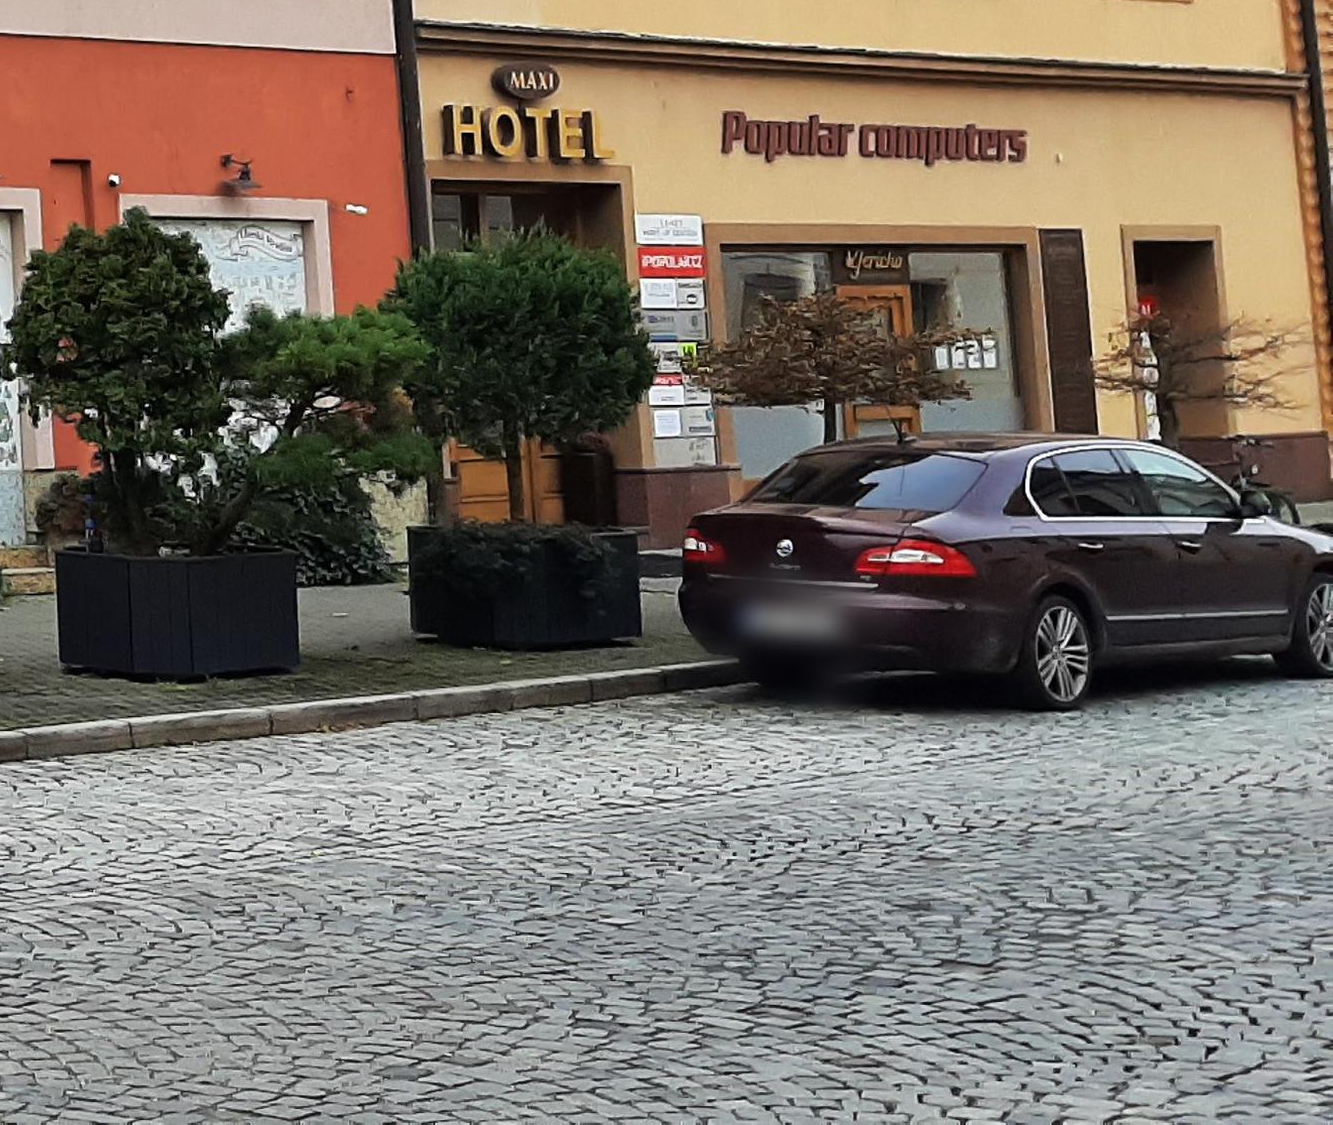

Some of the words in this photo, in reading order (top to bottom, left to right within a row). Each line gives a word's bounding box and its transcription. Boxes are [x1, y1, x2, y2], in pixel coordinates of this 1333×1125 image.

[509, 71, 555, 91] MAXI
[441, 103, 615, 160] HOTEL
[720, 110, 855, 163] Popular
[857, 123, 1028, 167] computers
